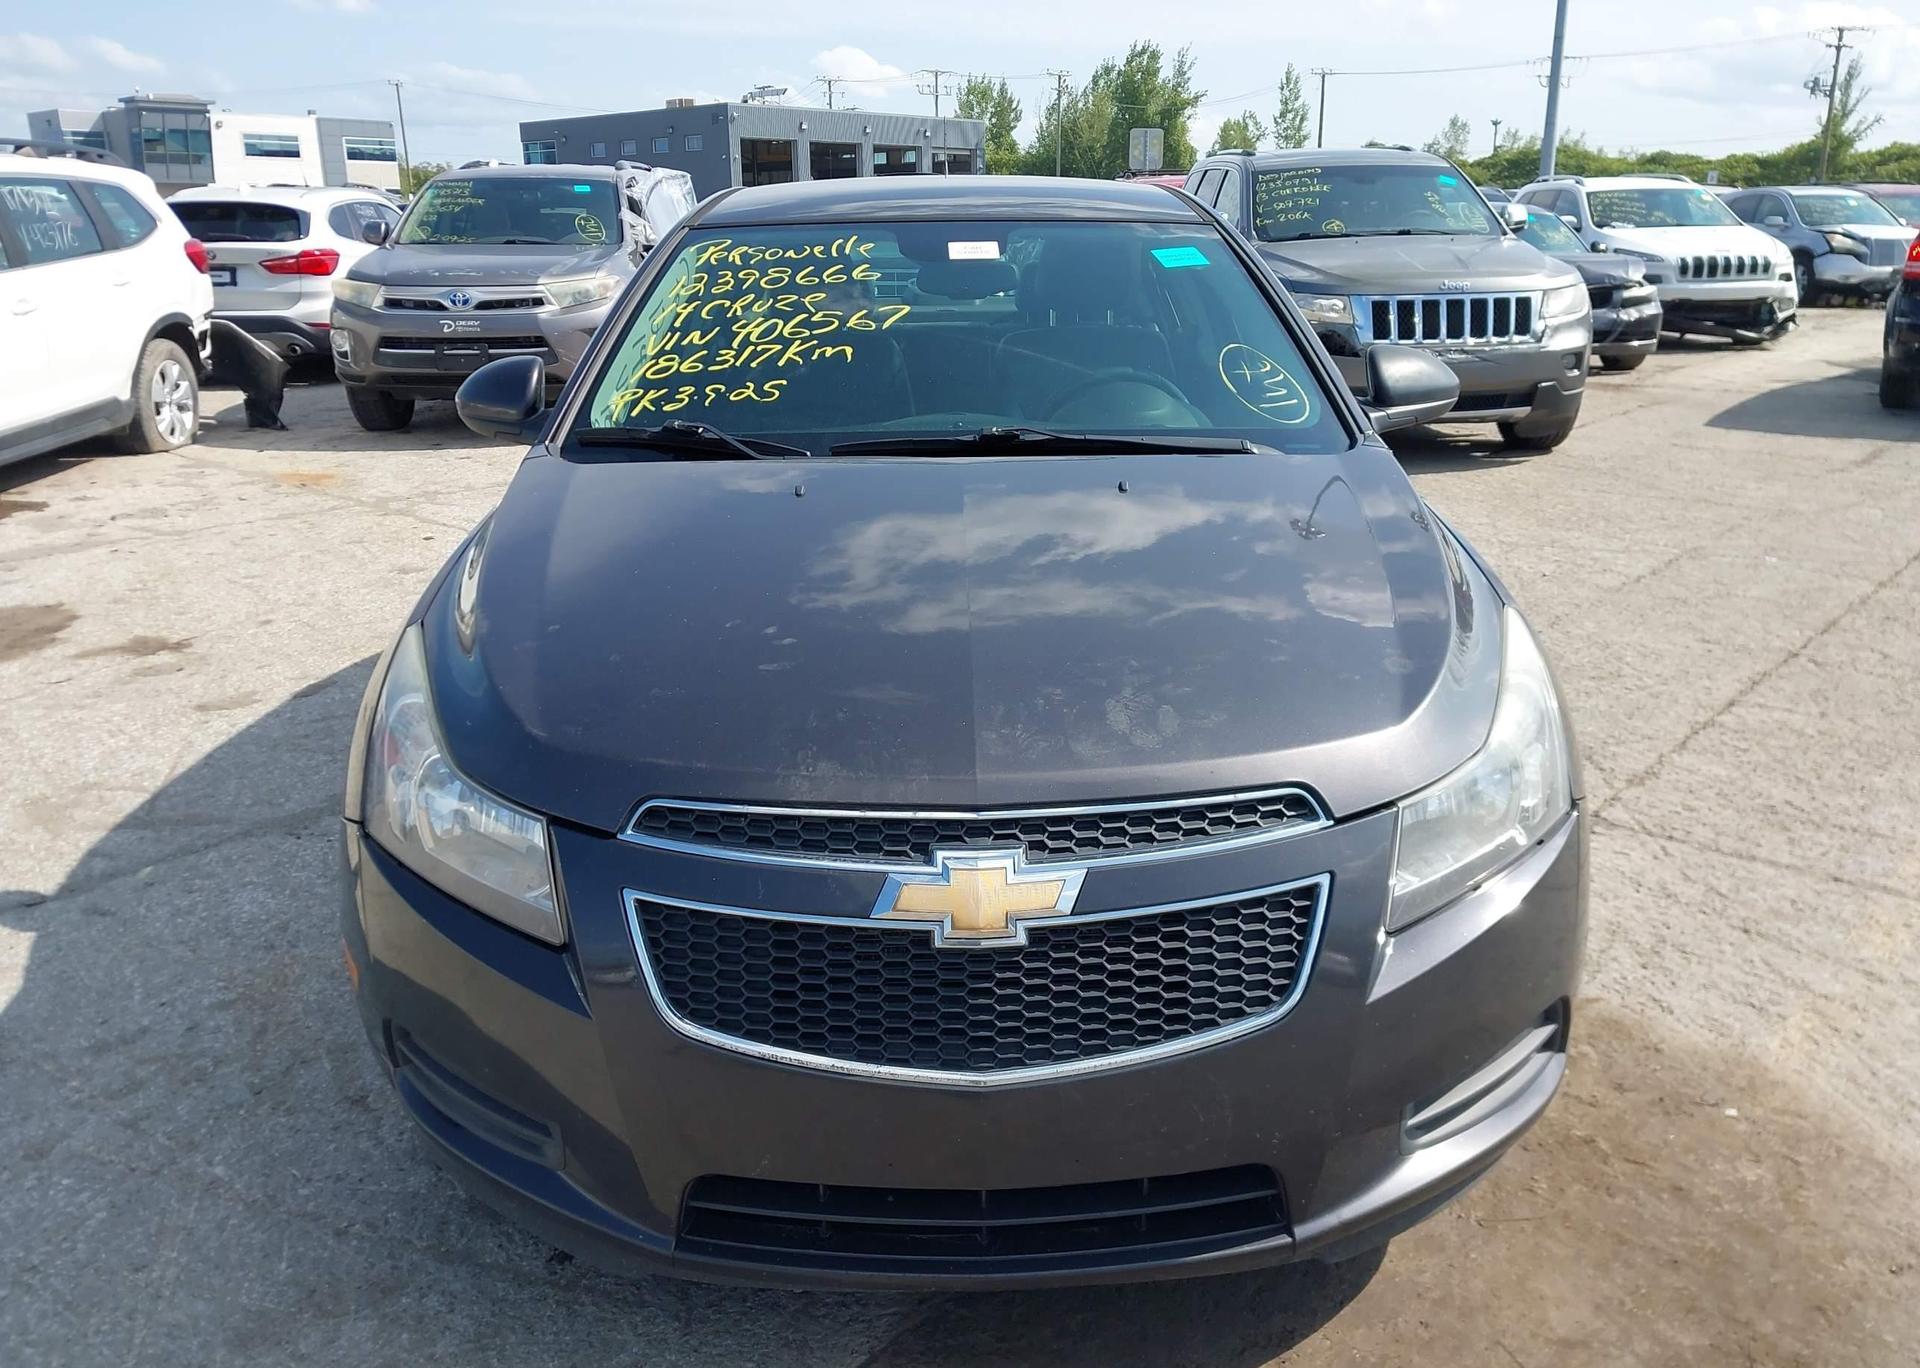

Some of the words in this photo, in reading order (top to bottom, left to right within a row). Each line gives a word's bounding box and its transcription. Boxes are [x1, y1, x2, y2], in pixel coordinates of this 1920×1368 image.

[1440, 280, 1470, 291] Jeep
[646, 327, 720, 356] VIN
[731, 305, 911, 350] 406567
